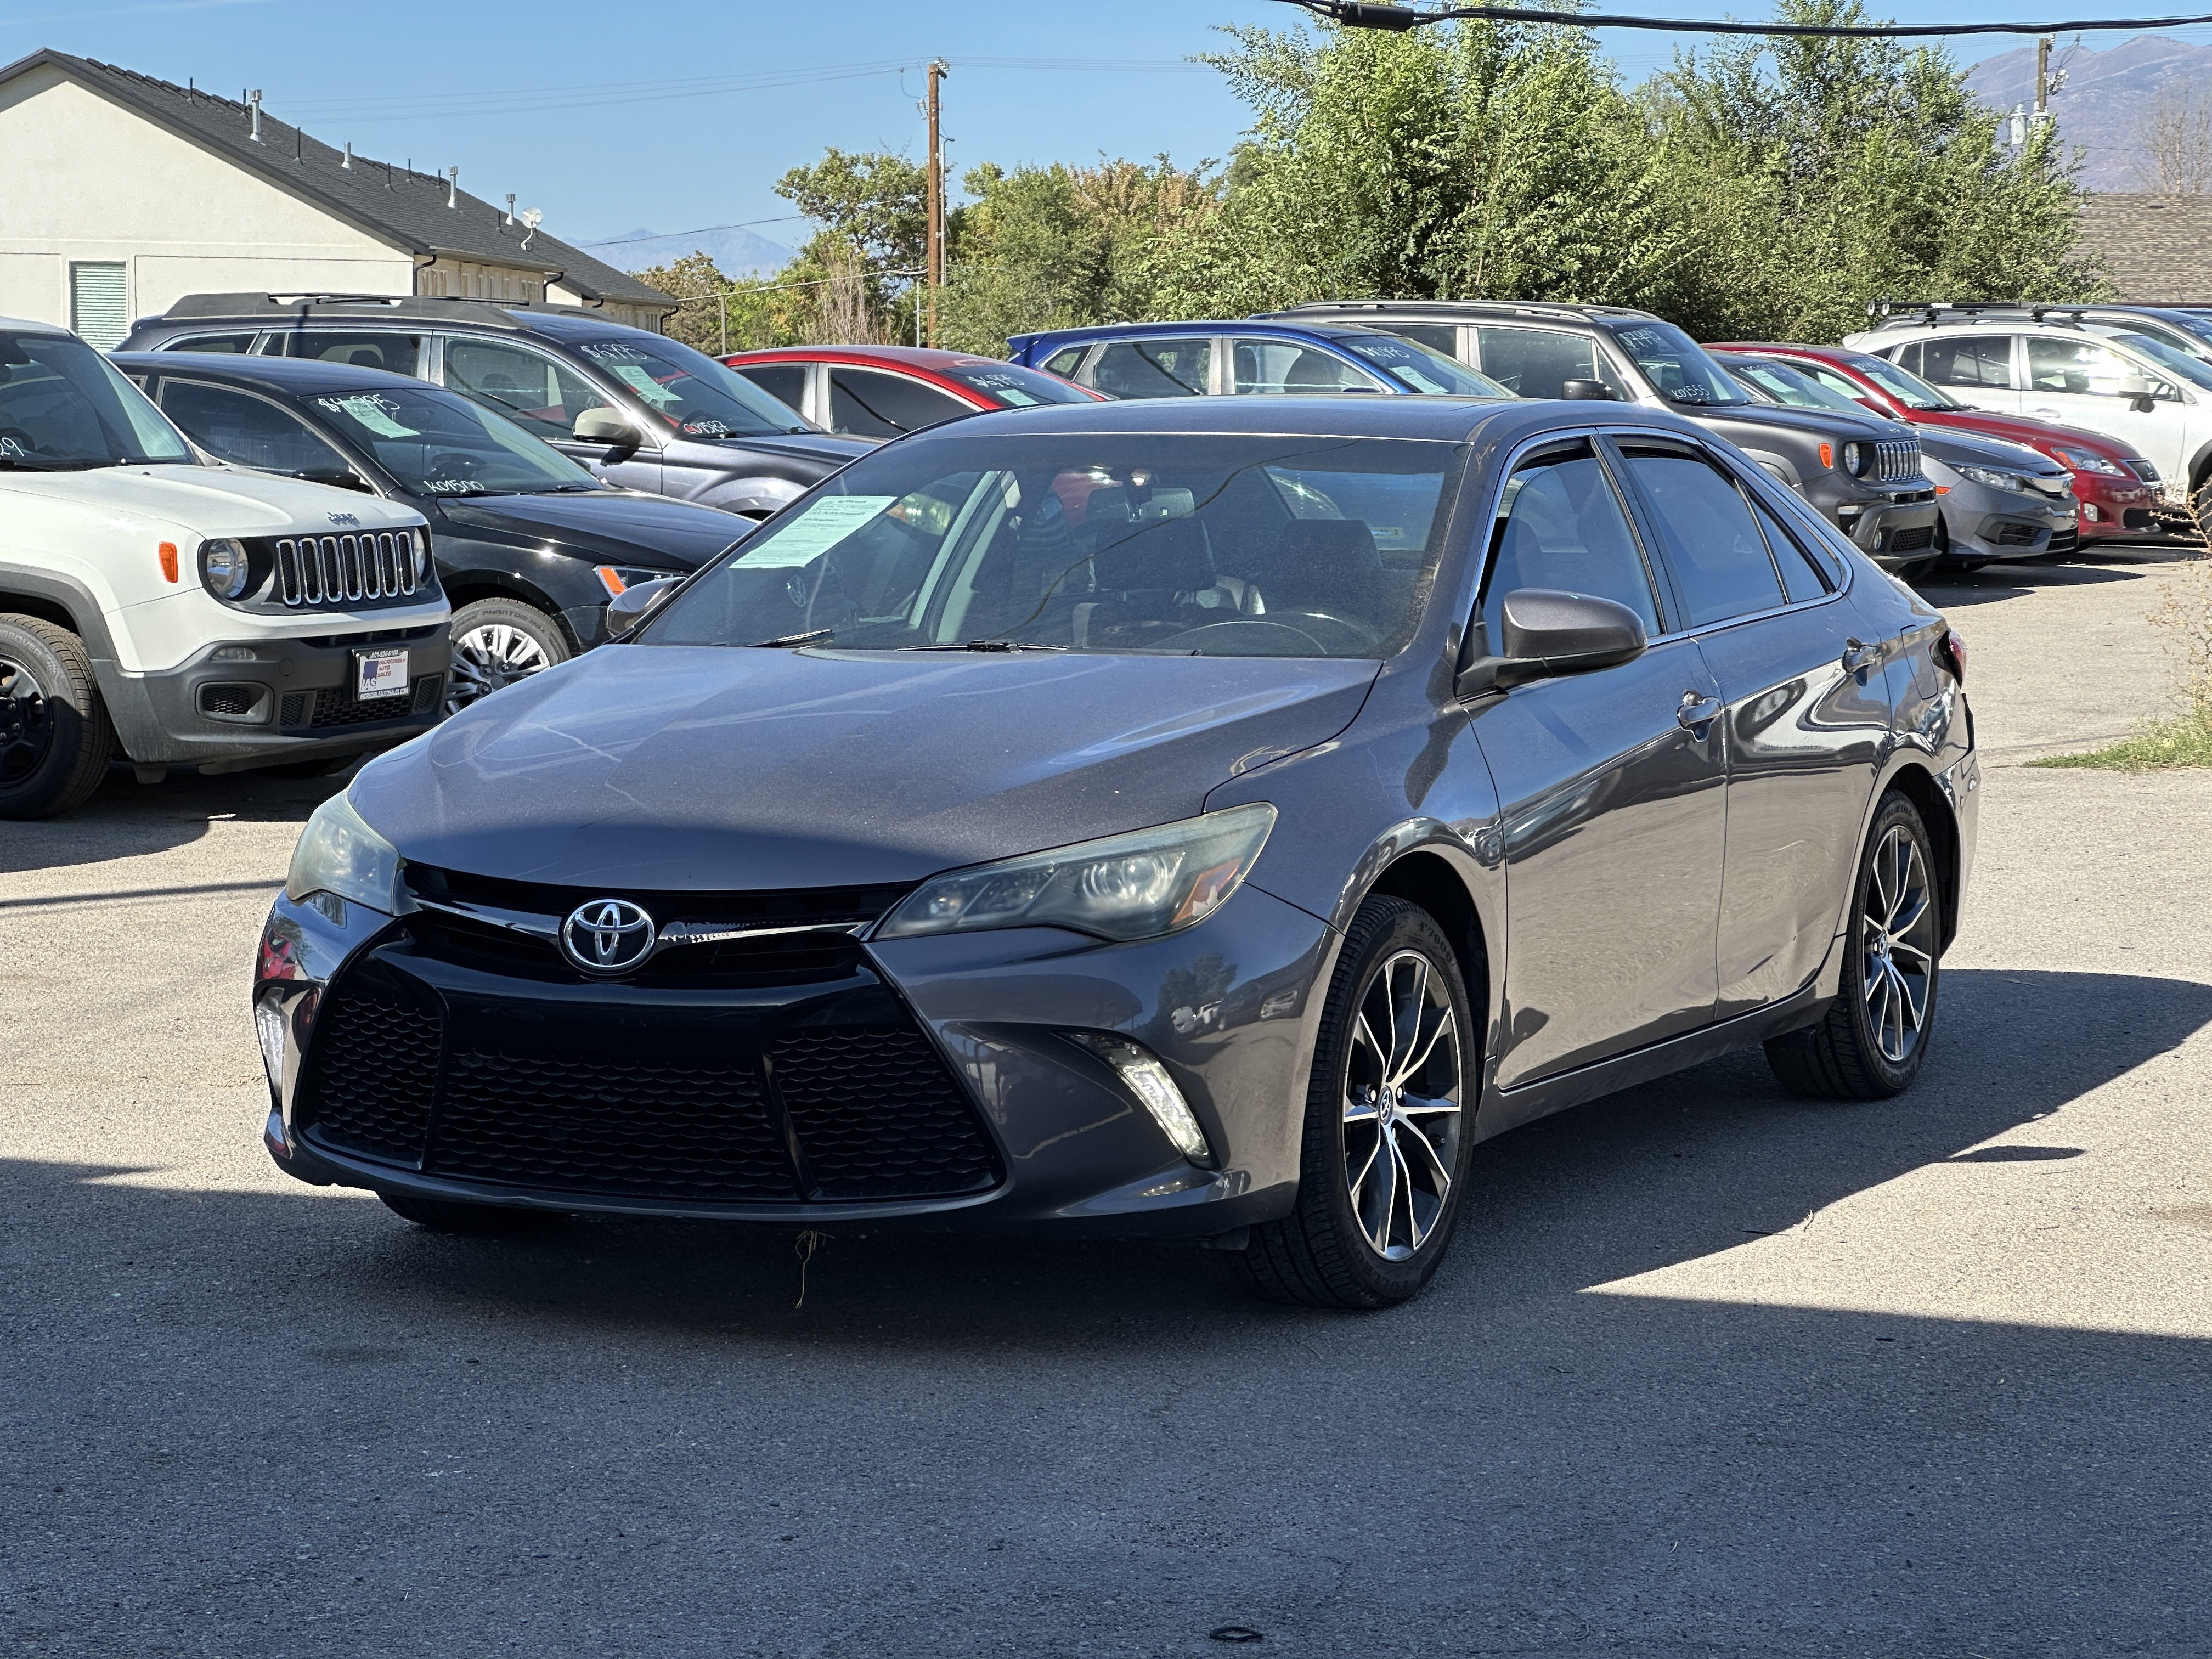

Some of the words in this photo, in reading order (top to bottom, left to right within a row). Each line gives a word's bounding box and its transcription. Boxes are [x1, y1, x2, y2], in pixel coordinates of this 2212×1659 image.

[580, 344, 648, 360] $6,995
[966, 374, 1025, 387] $6,995
[1671, 385, 1710, 399] K01555
[318, 394, 400, 413] $4,995
[327, 511, 361, 528] Jeep
[483, 609, 528, 620] PHANTOM
[362, 678, 376, 690] IAS
